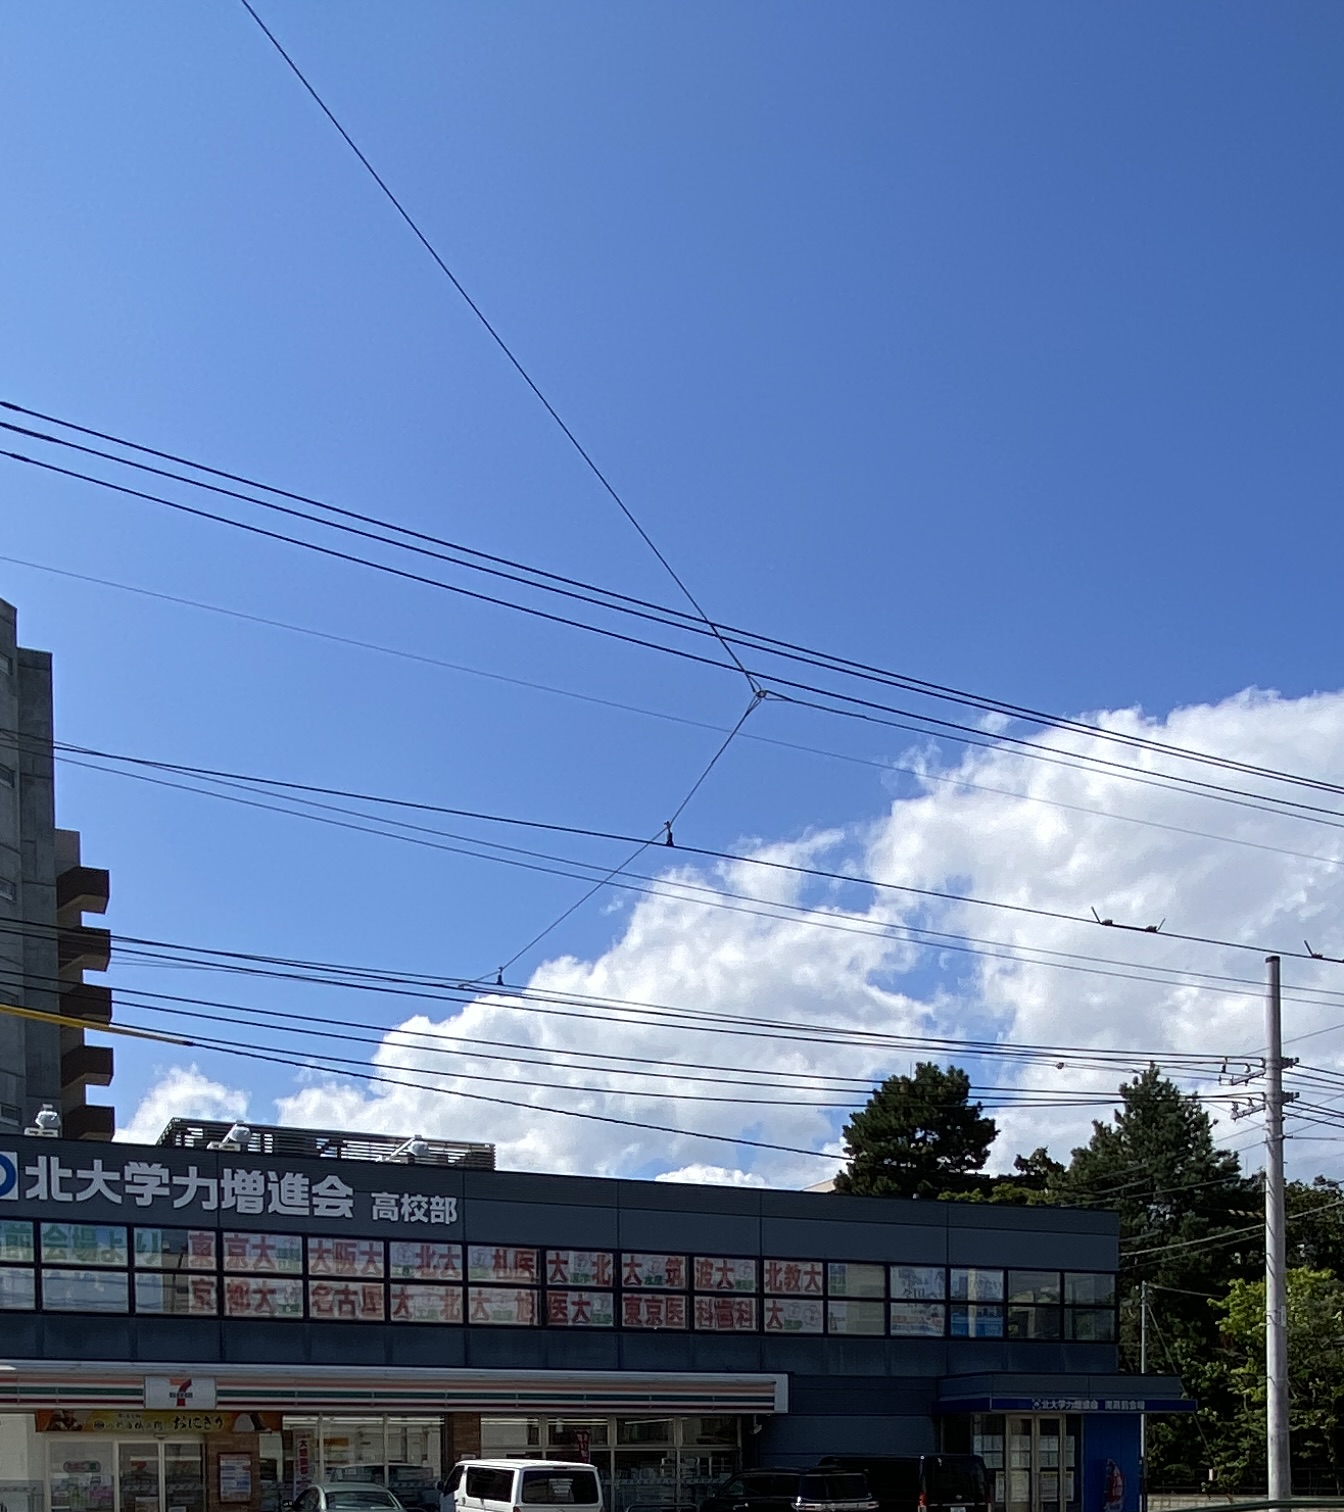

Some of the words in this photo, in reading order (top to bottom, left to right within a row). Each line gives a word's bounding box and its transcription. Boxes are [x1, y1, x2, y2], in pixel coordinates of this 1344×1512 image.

[25, 1155, 355, 1218] 北大学力増進会
[370, 1192, 458, 1225] 高校部
[765, 1261, 822, 1294] 北教大
